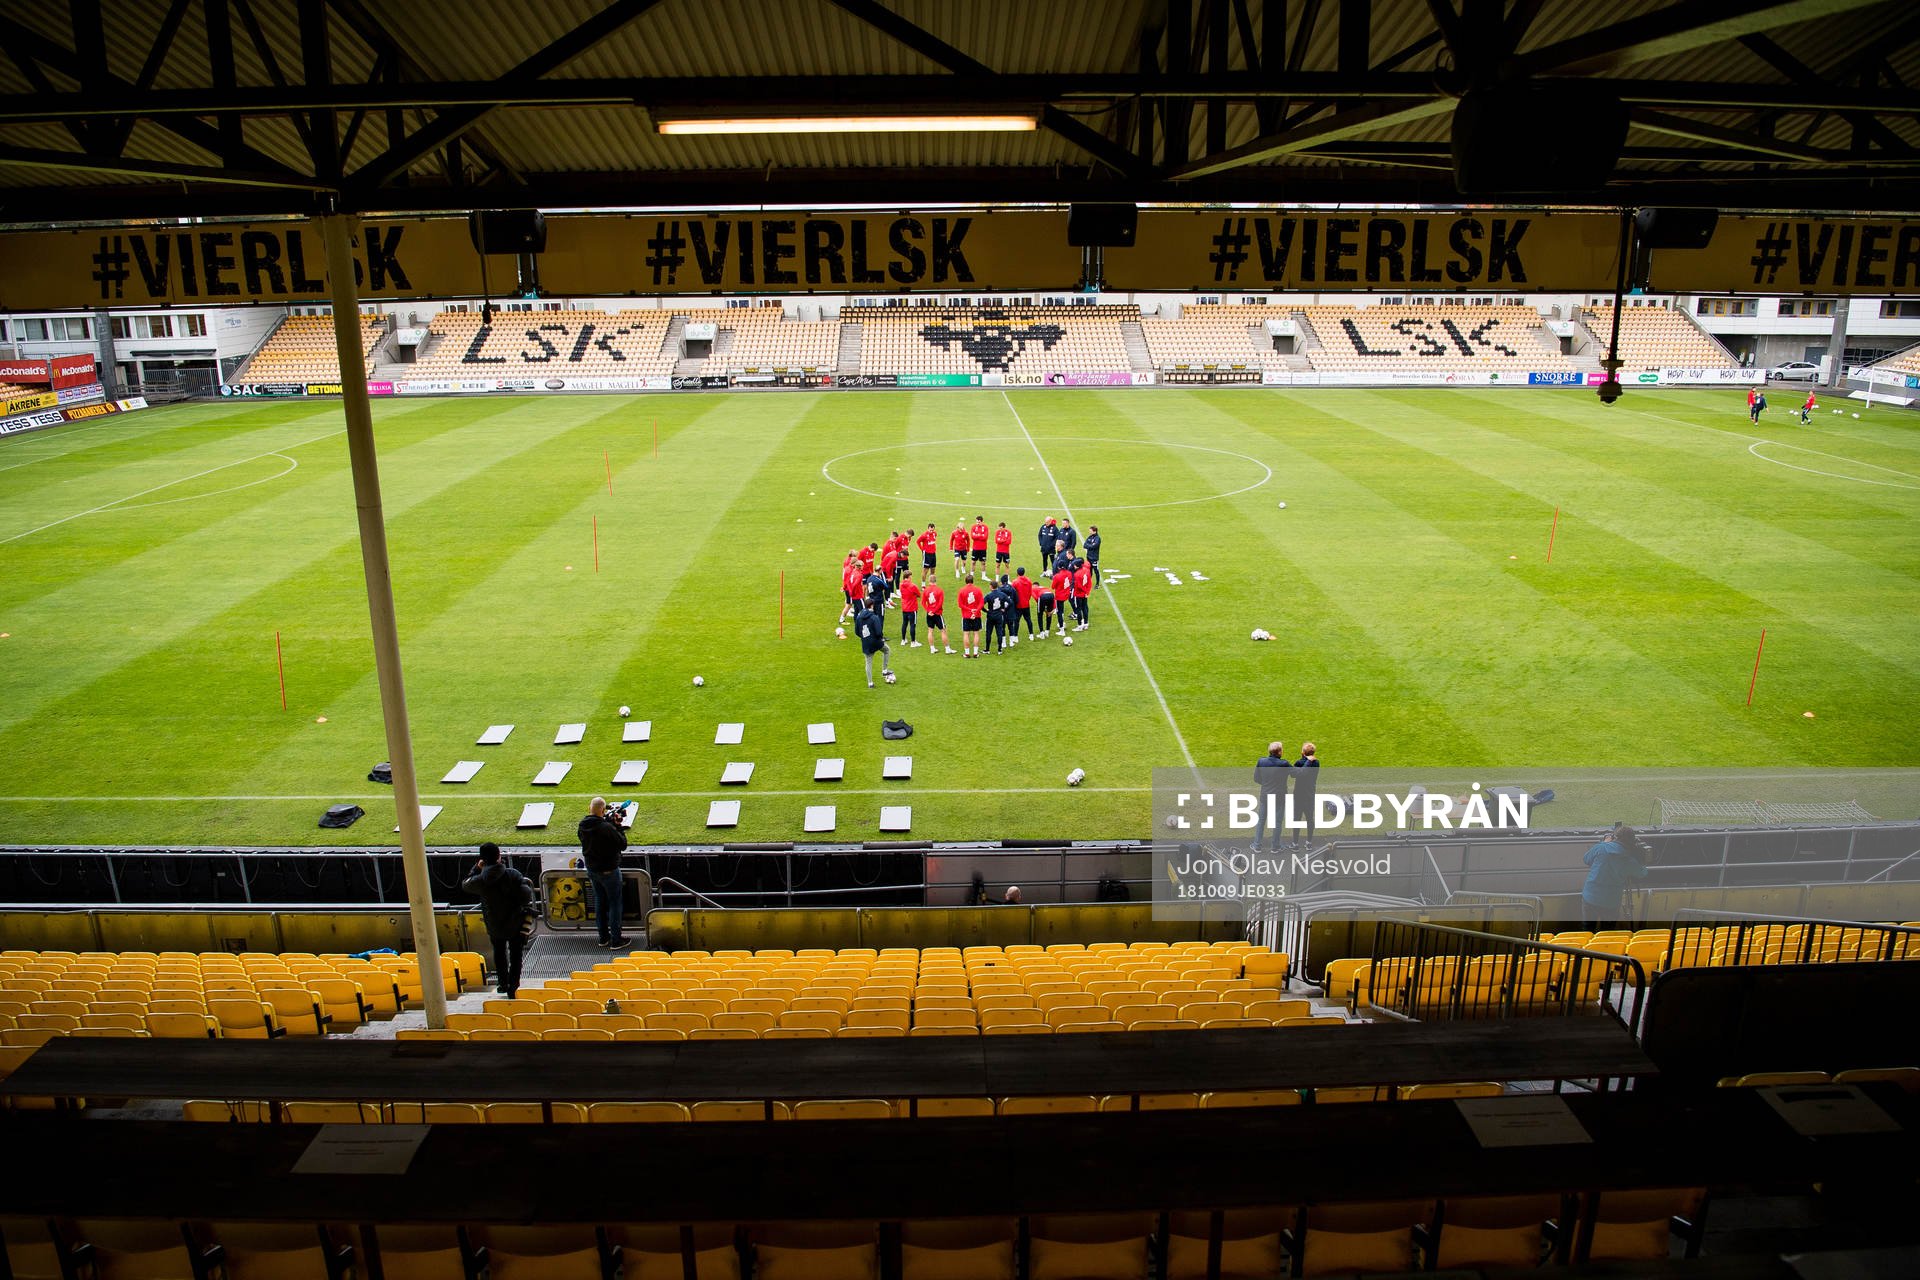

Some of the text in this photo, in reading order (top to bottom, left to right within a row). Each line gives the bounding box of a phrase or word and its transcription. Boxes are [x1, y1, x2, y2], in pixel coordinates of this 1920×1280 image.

[646, 218, 974, 285] #VIERLSK
[1209, 218, 1531, 283] #VIERLSK
[61, 364, 95, 376] McDonald's
[1535, 373, 1577, 382] SNORRE
[232, 384, 262, 395] SAC
[0, 411, 62, 433] TESS TESS
